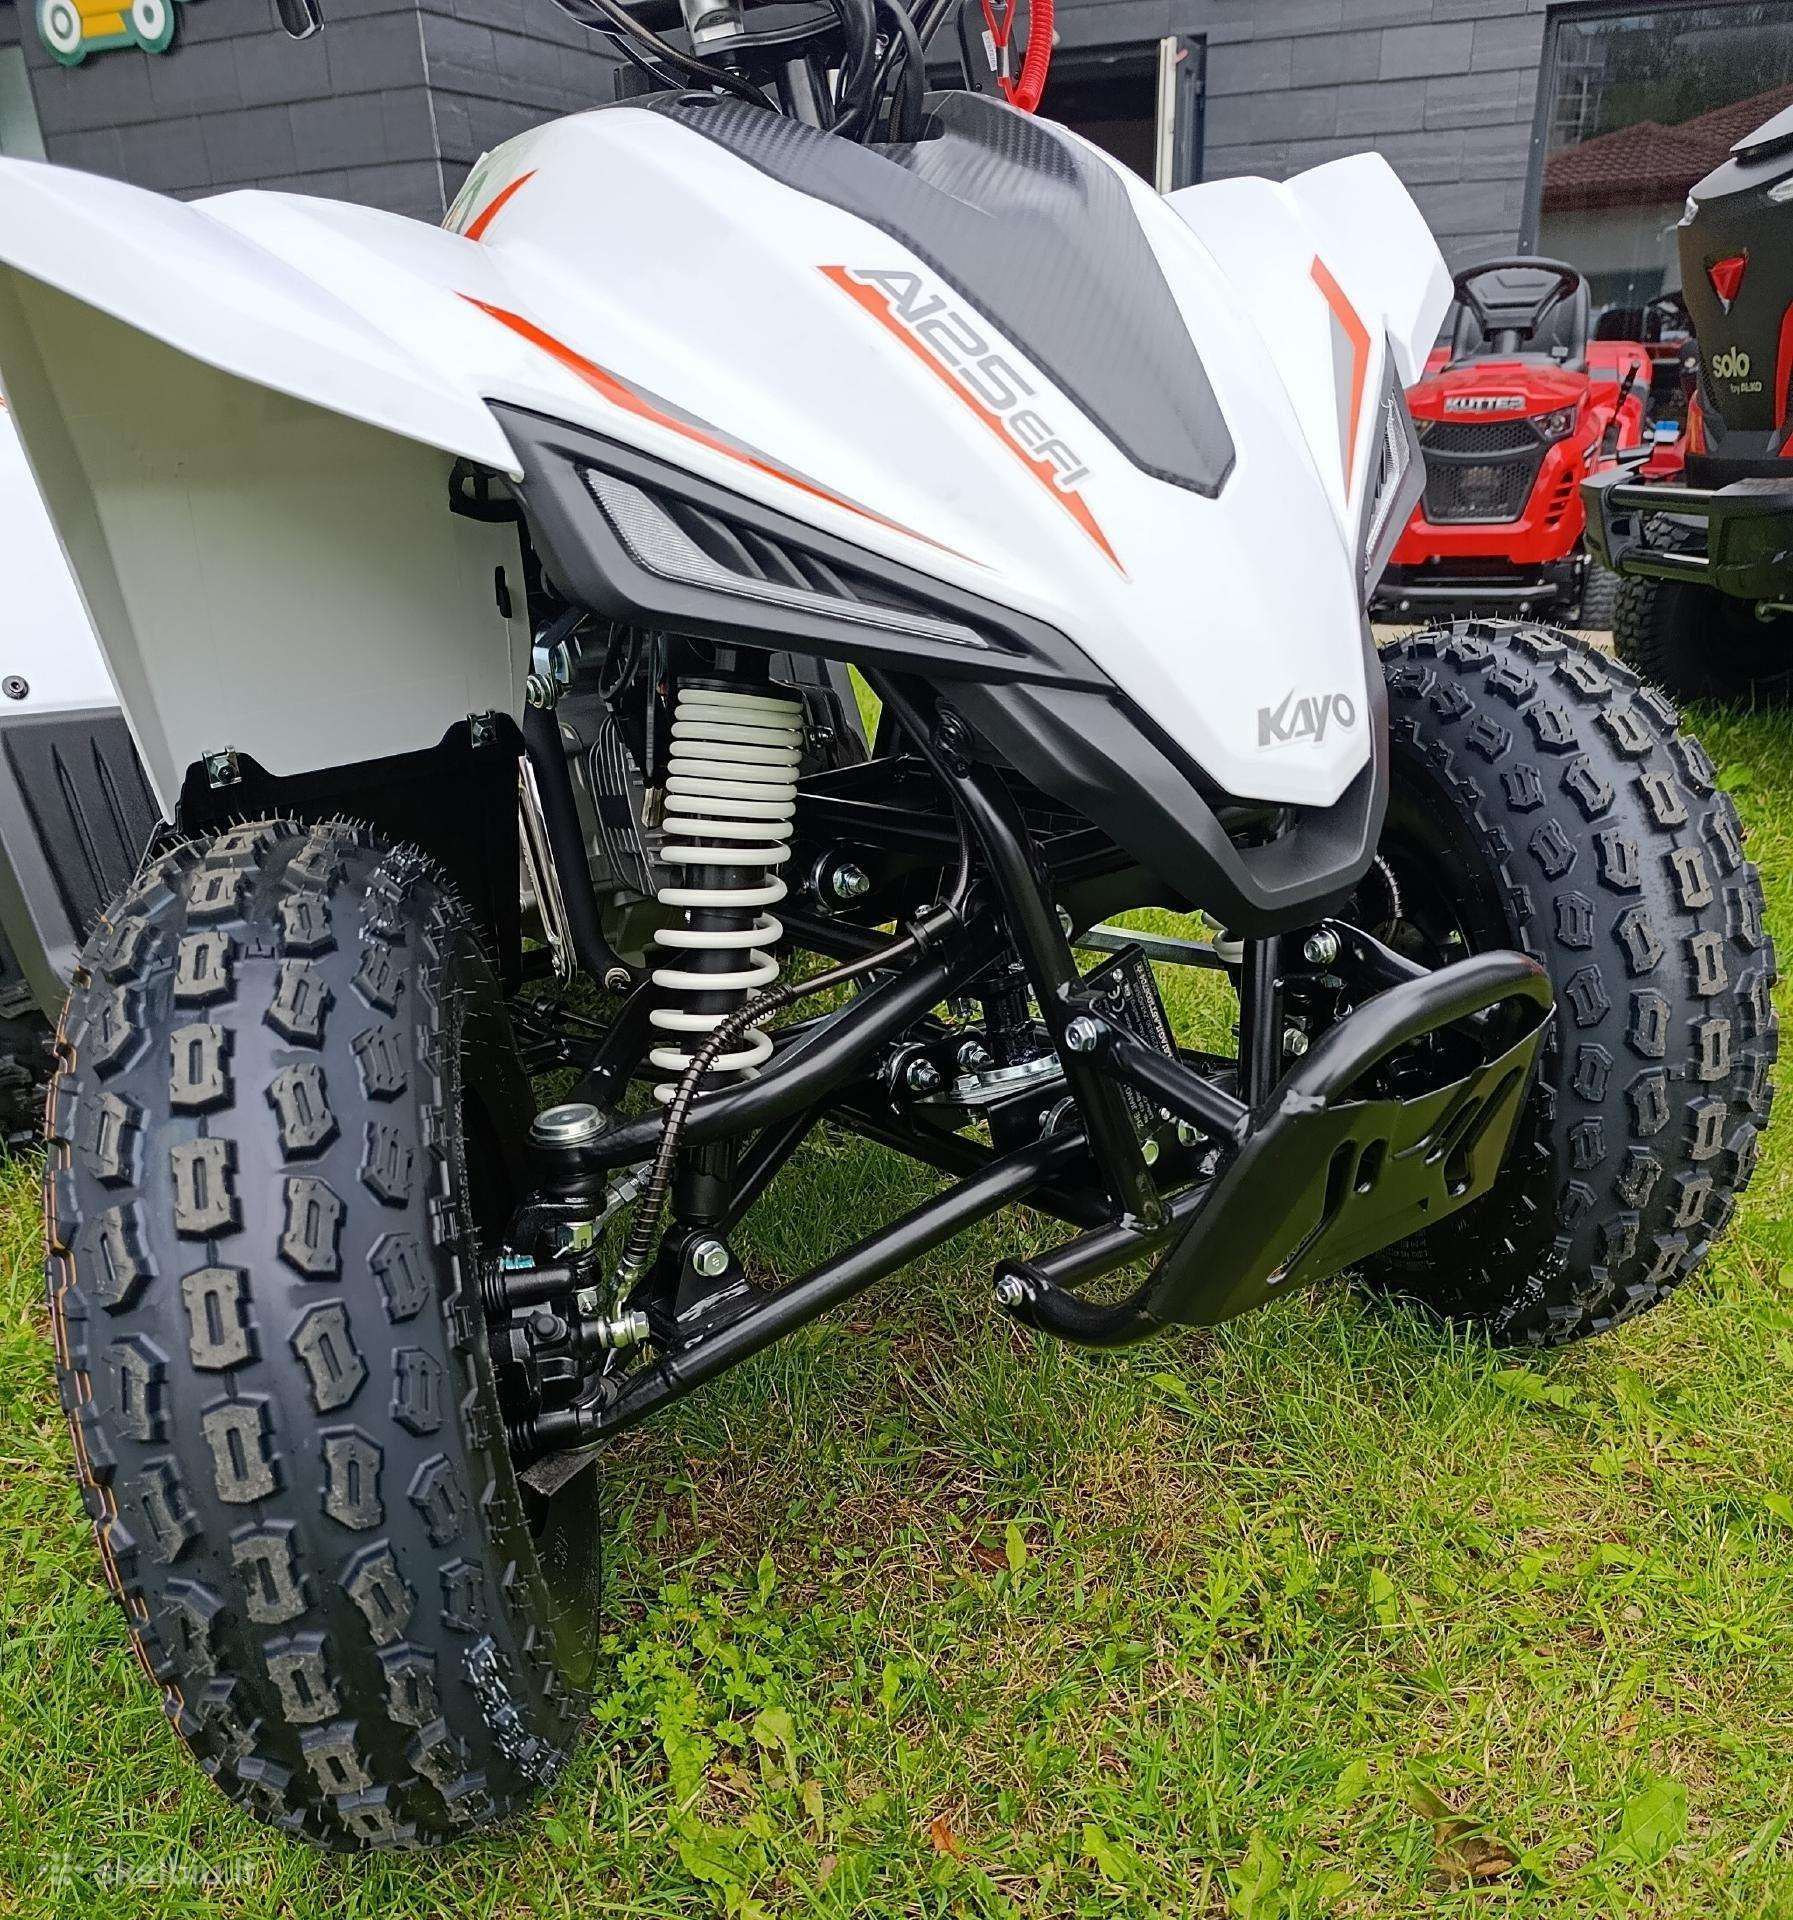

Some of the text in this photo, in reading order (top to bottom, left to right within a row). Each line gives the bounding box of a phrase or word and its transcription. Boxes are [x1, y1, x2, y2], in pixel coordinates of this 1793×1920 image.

[852, 269, 1091, 486] A125 EFI
[1712, 346, 1750, 378] solo
[1257, 687, 1356, 747] KAYO
